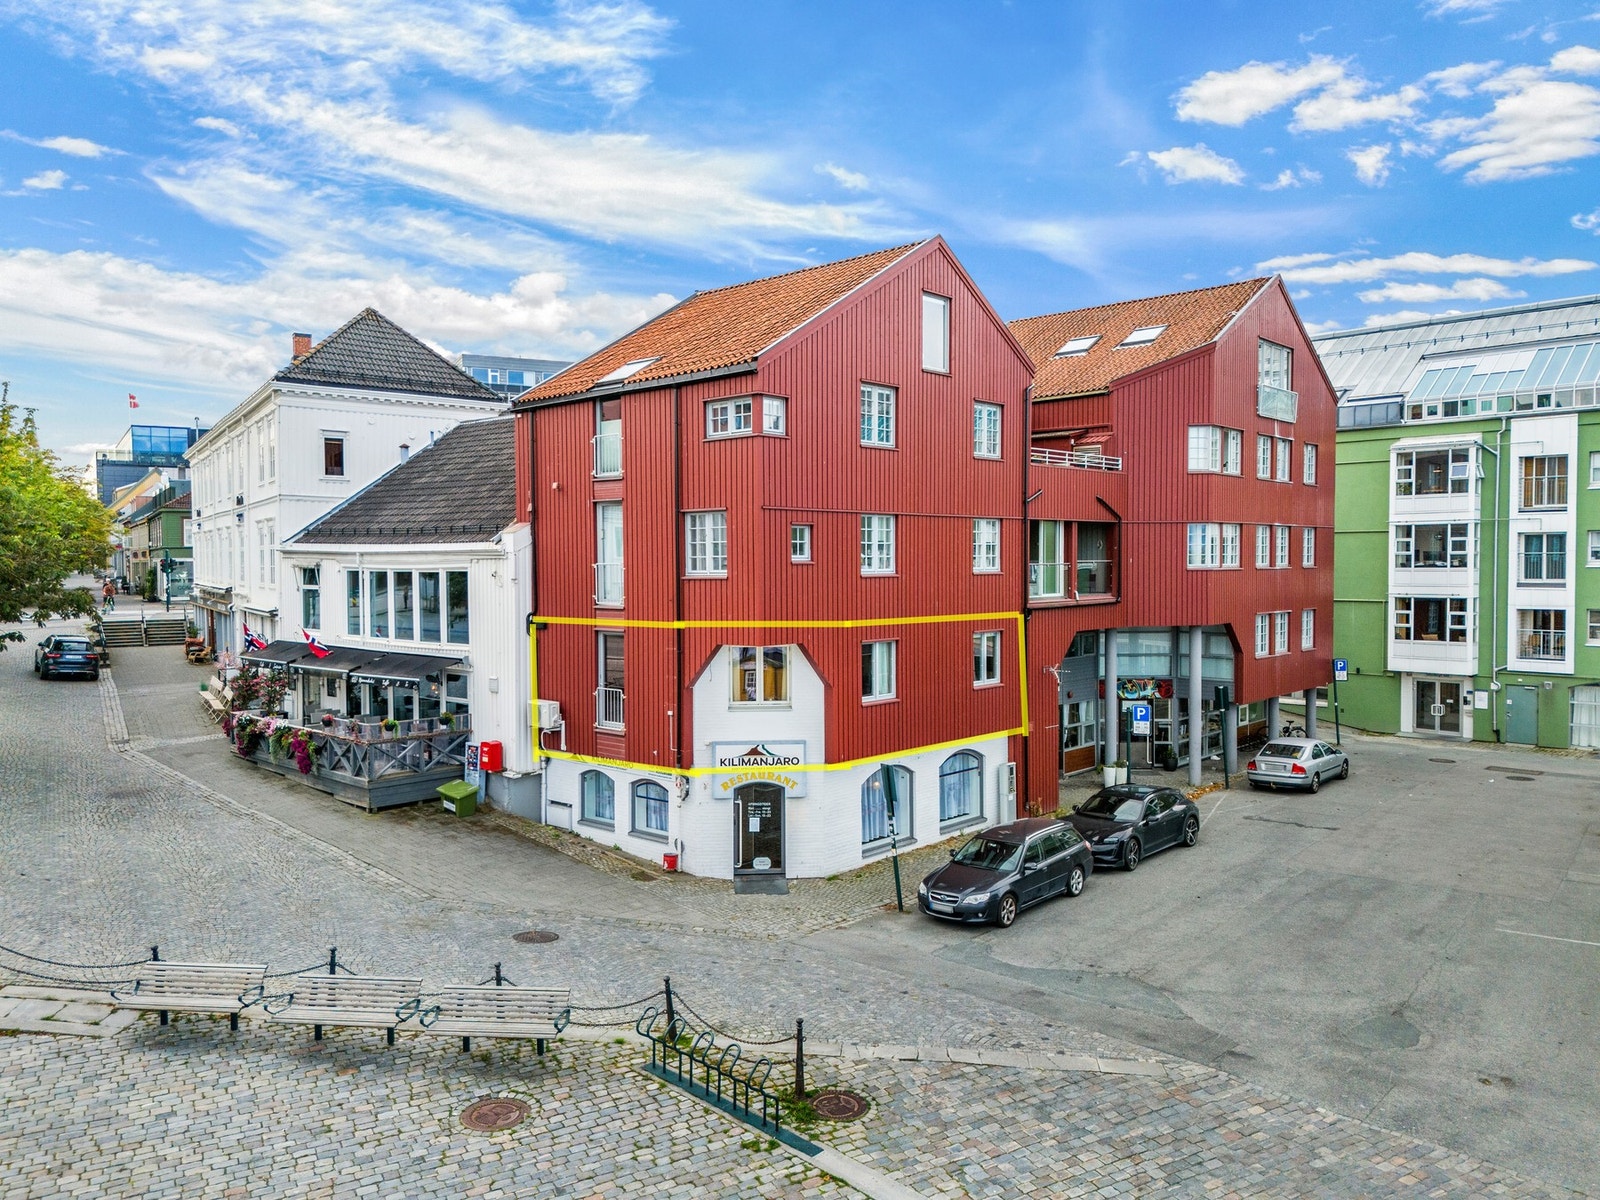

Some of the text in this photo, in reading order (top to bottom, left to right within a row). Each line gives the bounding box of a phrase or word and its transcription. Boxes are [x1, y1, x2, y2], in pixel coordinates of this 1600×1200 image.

[1337, 661, 1344, 670] P
[1137, 707, 1146, 720] P
[592, 756, 634, 769] KILIMANJARO
[720, 757, 800, 767] KILIMANJARO
[720, 772, 799, 792] RESTAURANT
